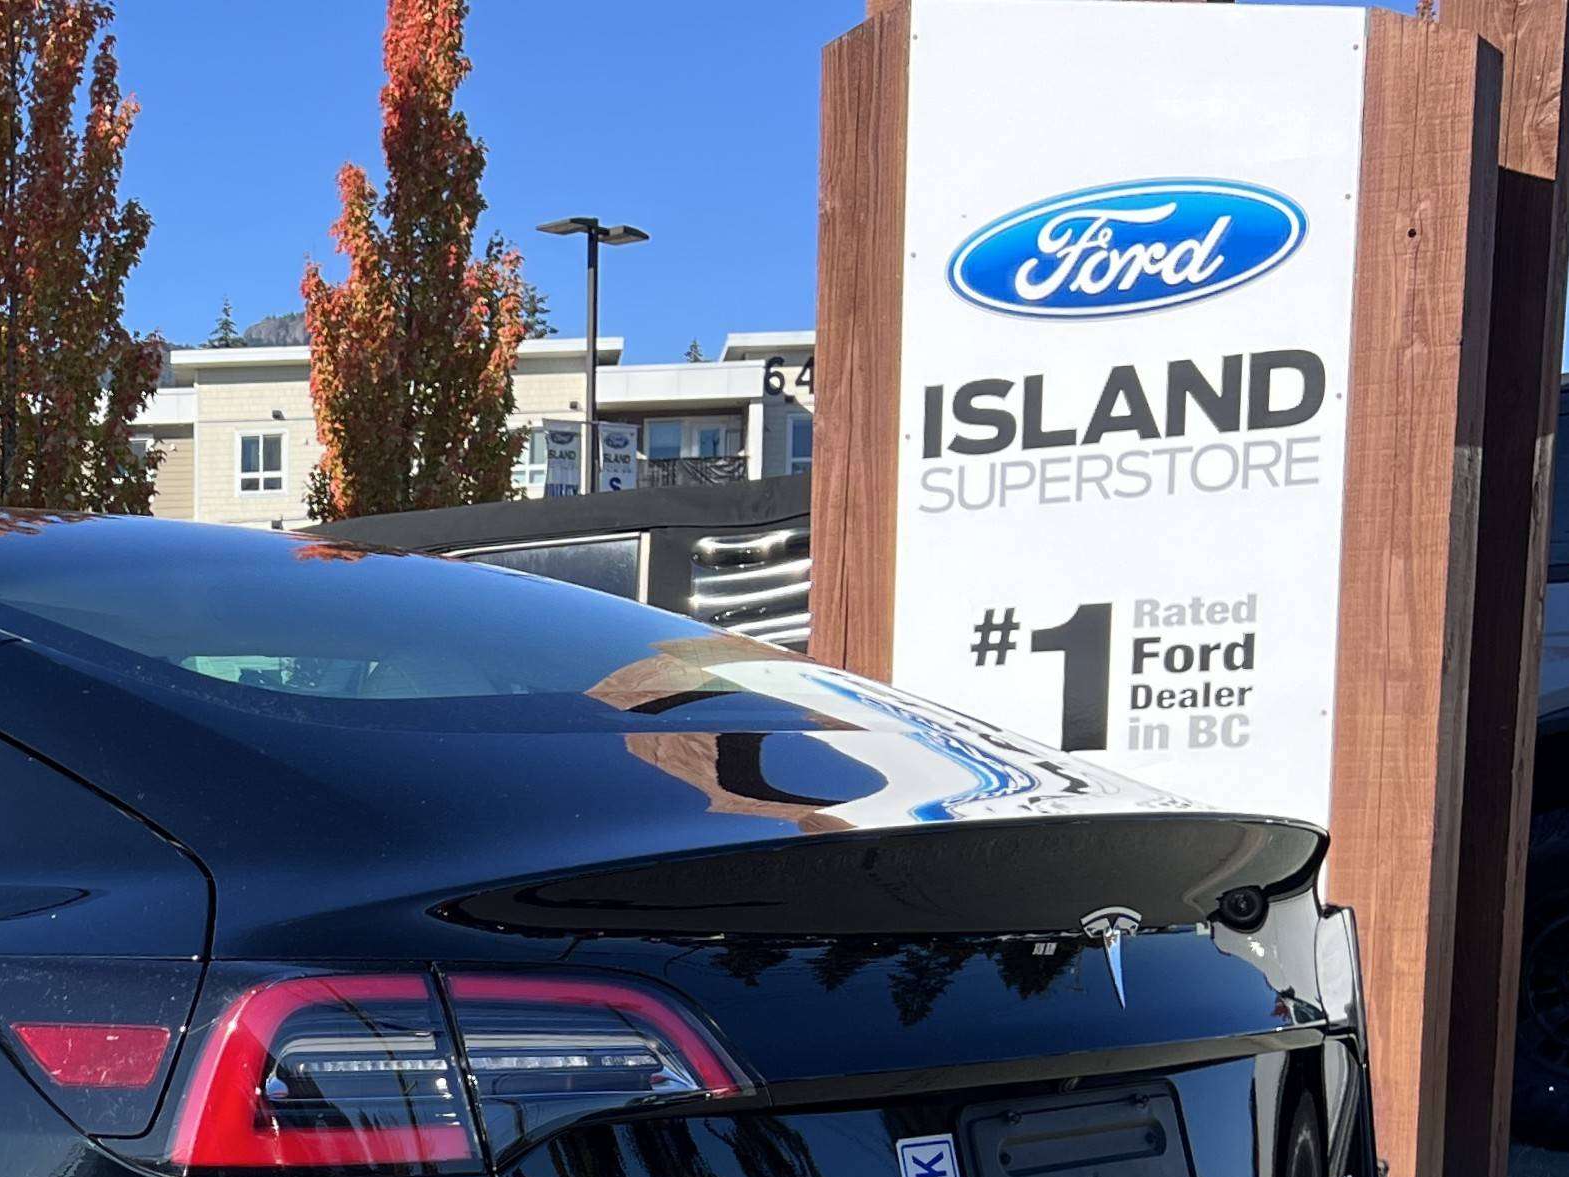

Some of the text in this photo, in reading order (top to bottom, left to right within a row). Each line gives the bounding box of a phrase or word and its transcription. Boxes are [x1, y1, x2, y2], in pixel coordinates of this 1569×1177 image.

[1015, 201, 1232, 301] Ford
[922, 349, 1326, 459] ISLAND
[548, 449, 577, 461] SLAND
[603, 453, 631, 465] SLAND
[918, 435, 1322, 514] SUPERSTORE
[1133, 594, 1258, 628] Rated
[1131, 633, 1256, 675] Ford
[1130, 682, 1253, 710] Dealer
[1128, 713, 1251, 751] in BC
